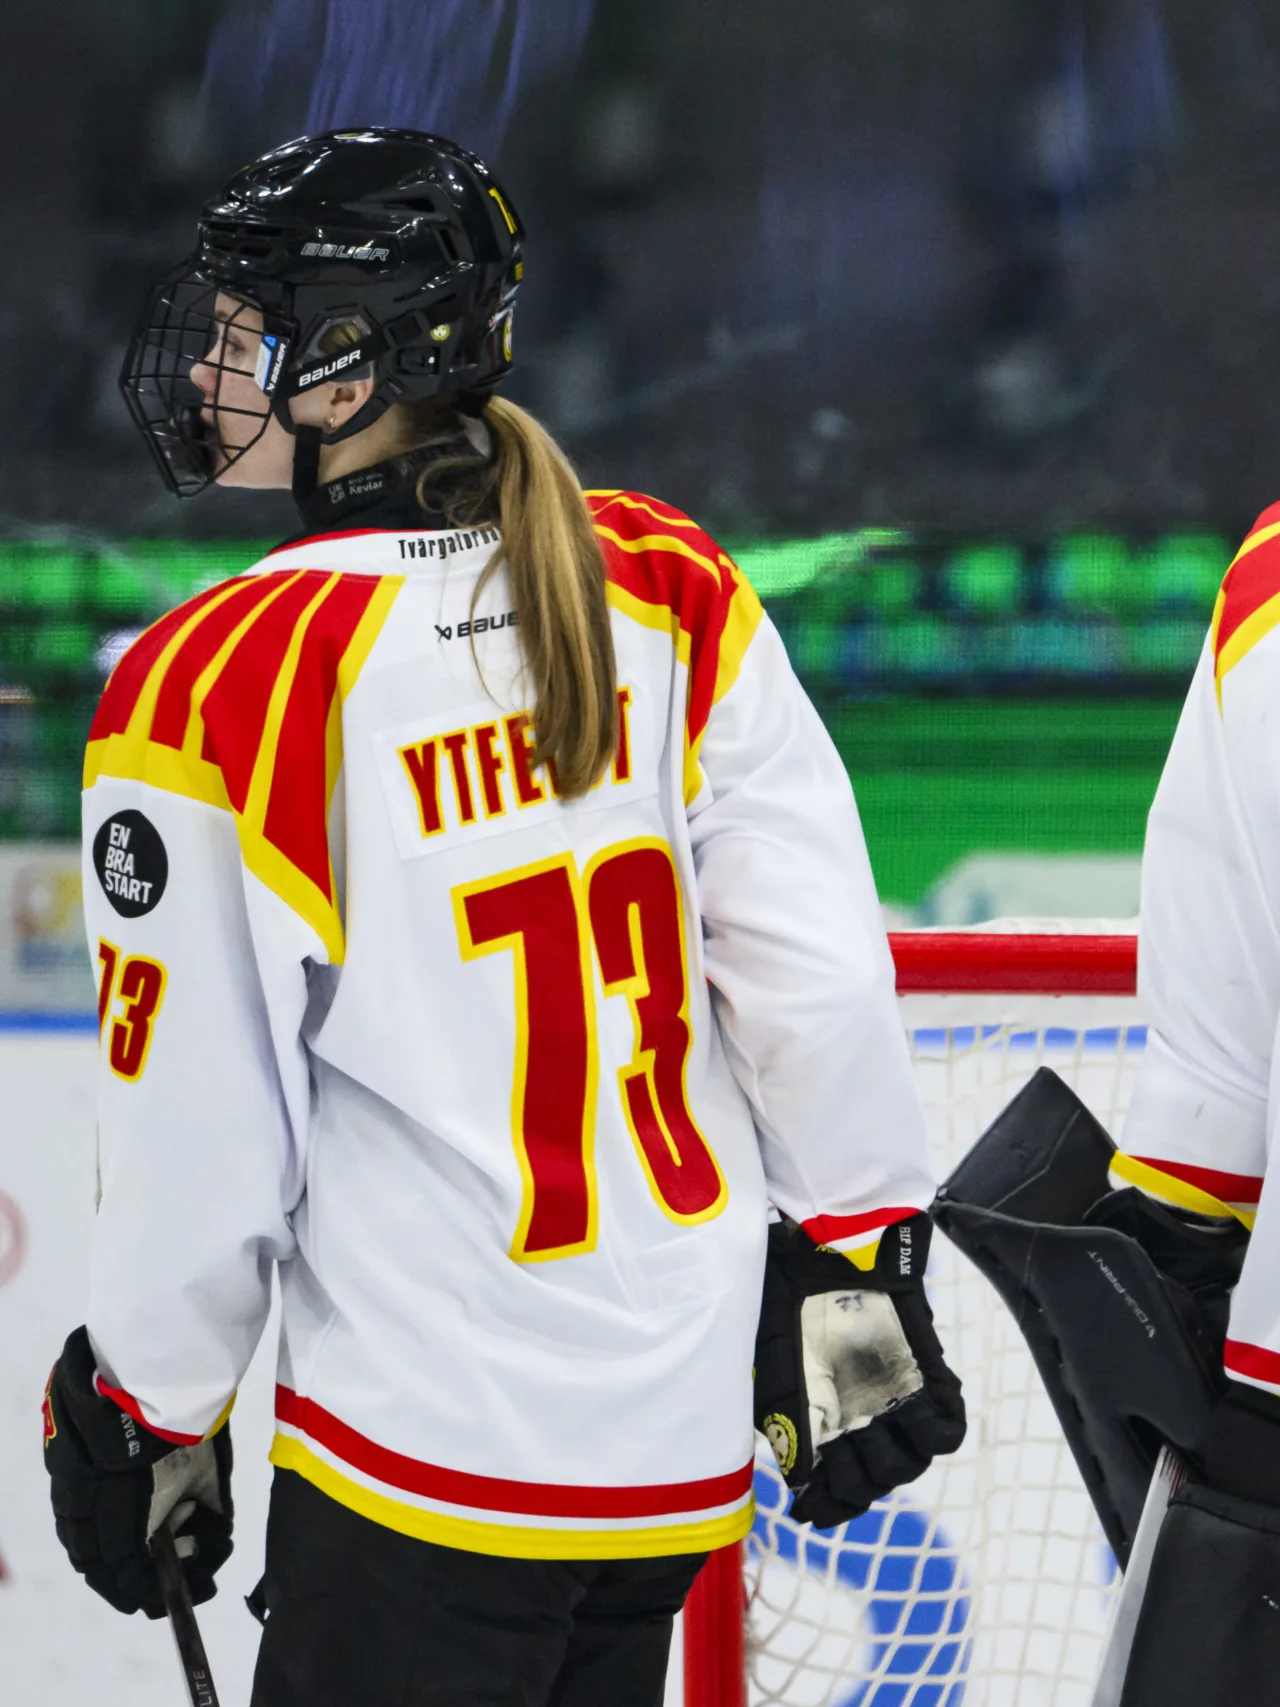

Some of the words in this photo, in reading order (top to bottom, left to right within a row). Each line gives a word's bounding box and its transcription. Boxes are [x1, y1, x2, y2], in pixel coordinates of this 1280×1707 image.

[300, 242, 389, 261] BAUER
[298, 348, 361, 387] BAUER
[457, 610, 521, 638] BAUE
[397, 685, 633, 840] YTFET
[109, 822, 132, 850] EN
[104, 848, 136, 876] BRA
[104, 869, 153, 904] START
[450, 834, 729, 1264] 73
[900, 1246, 913, 1276] DAM
